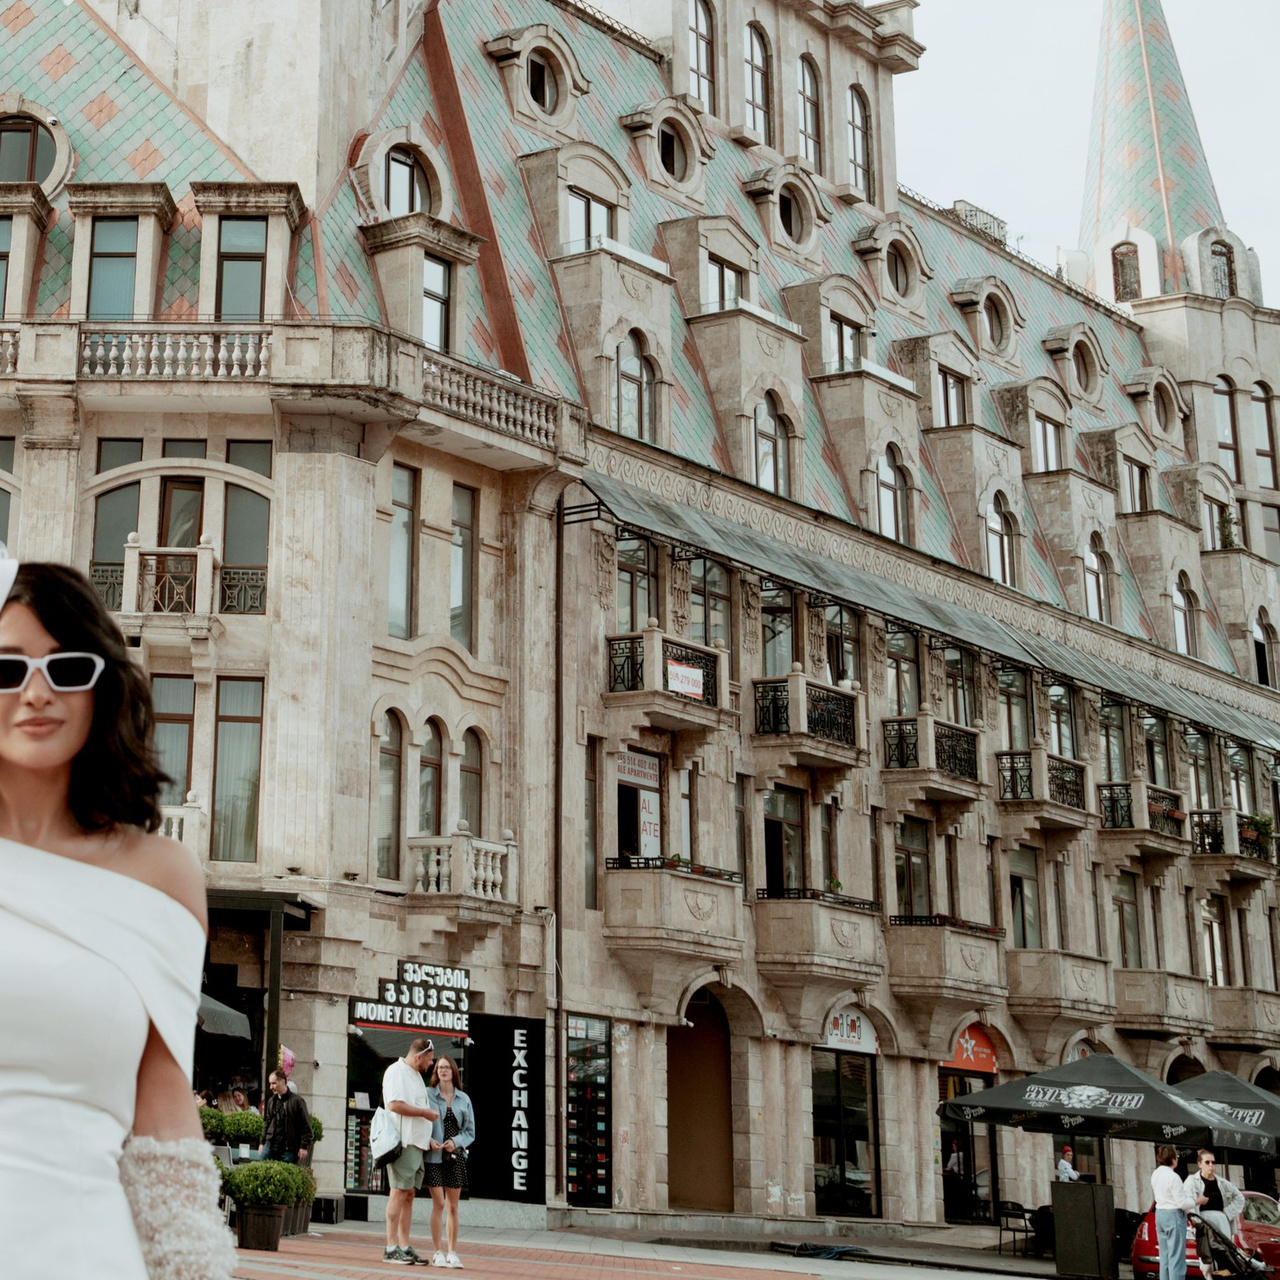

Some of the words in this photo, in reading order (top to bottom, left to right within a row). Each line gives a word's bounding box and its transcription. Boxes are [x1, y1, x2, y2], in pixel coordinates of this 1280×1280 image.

[627, 766, 659, 783] APARTMENTS
[403, 963, 469, 990] ვალუტის
[384, 983, 469, 1012] გაცვლა
[354, 1001, 402, 1024] MONEY
[402, 1007, 469, 1031] EXCHANGE
[511, 1029, 529, 1191] EXCHANGE
